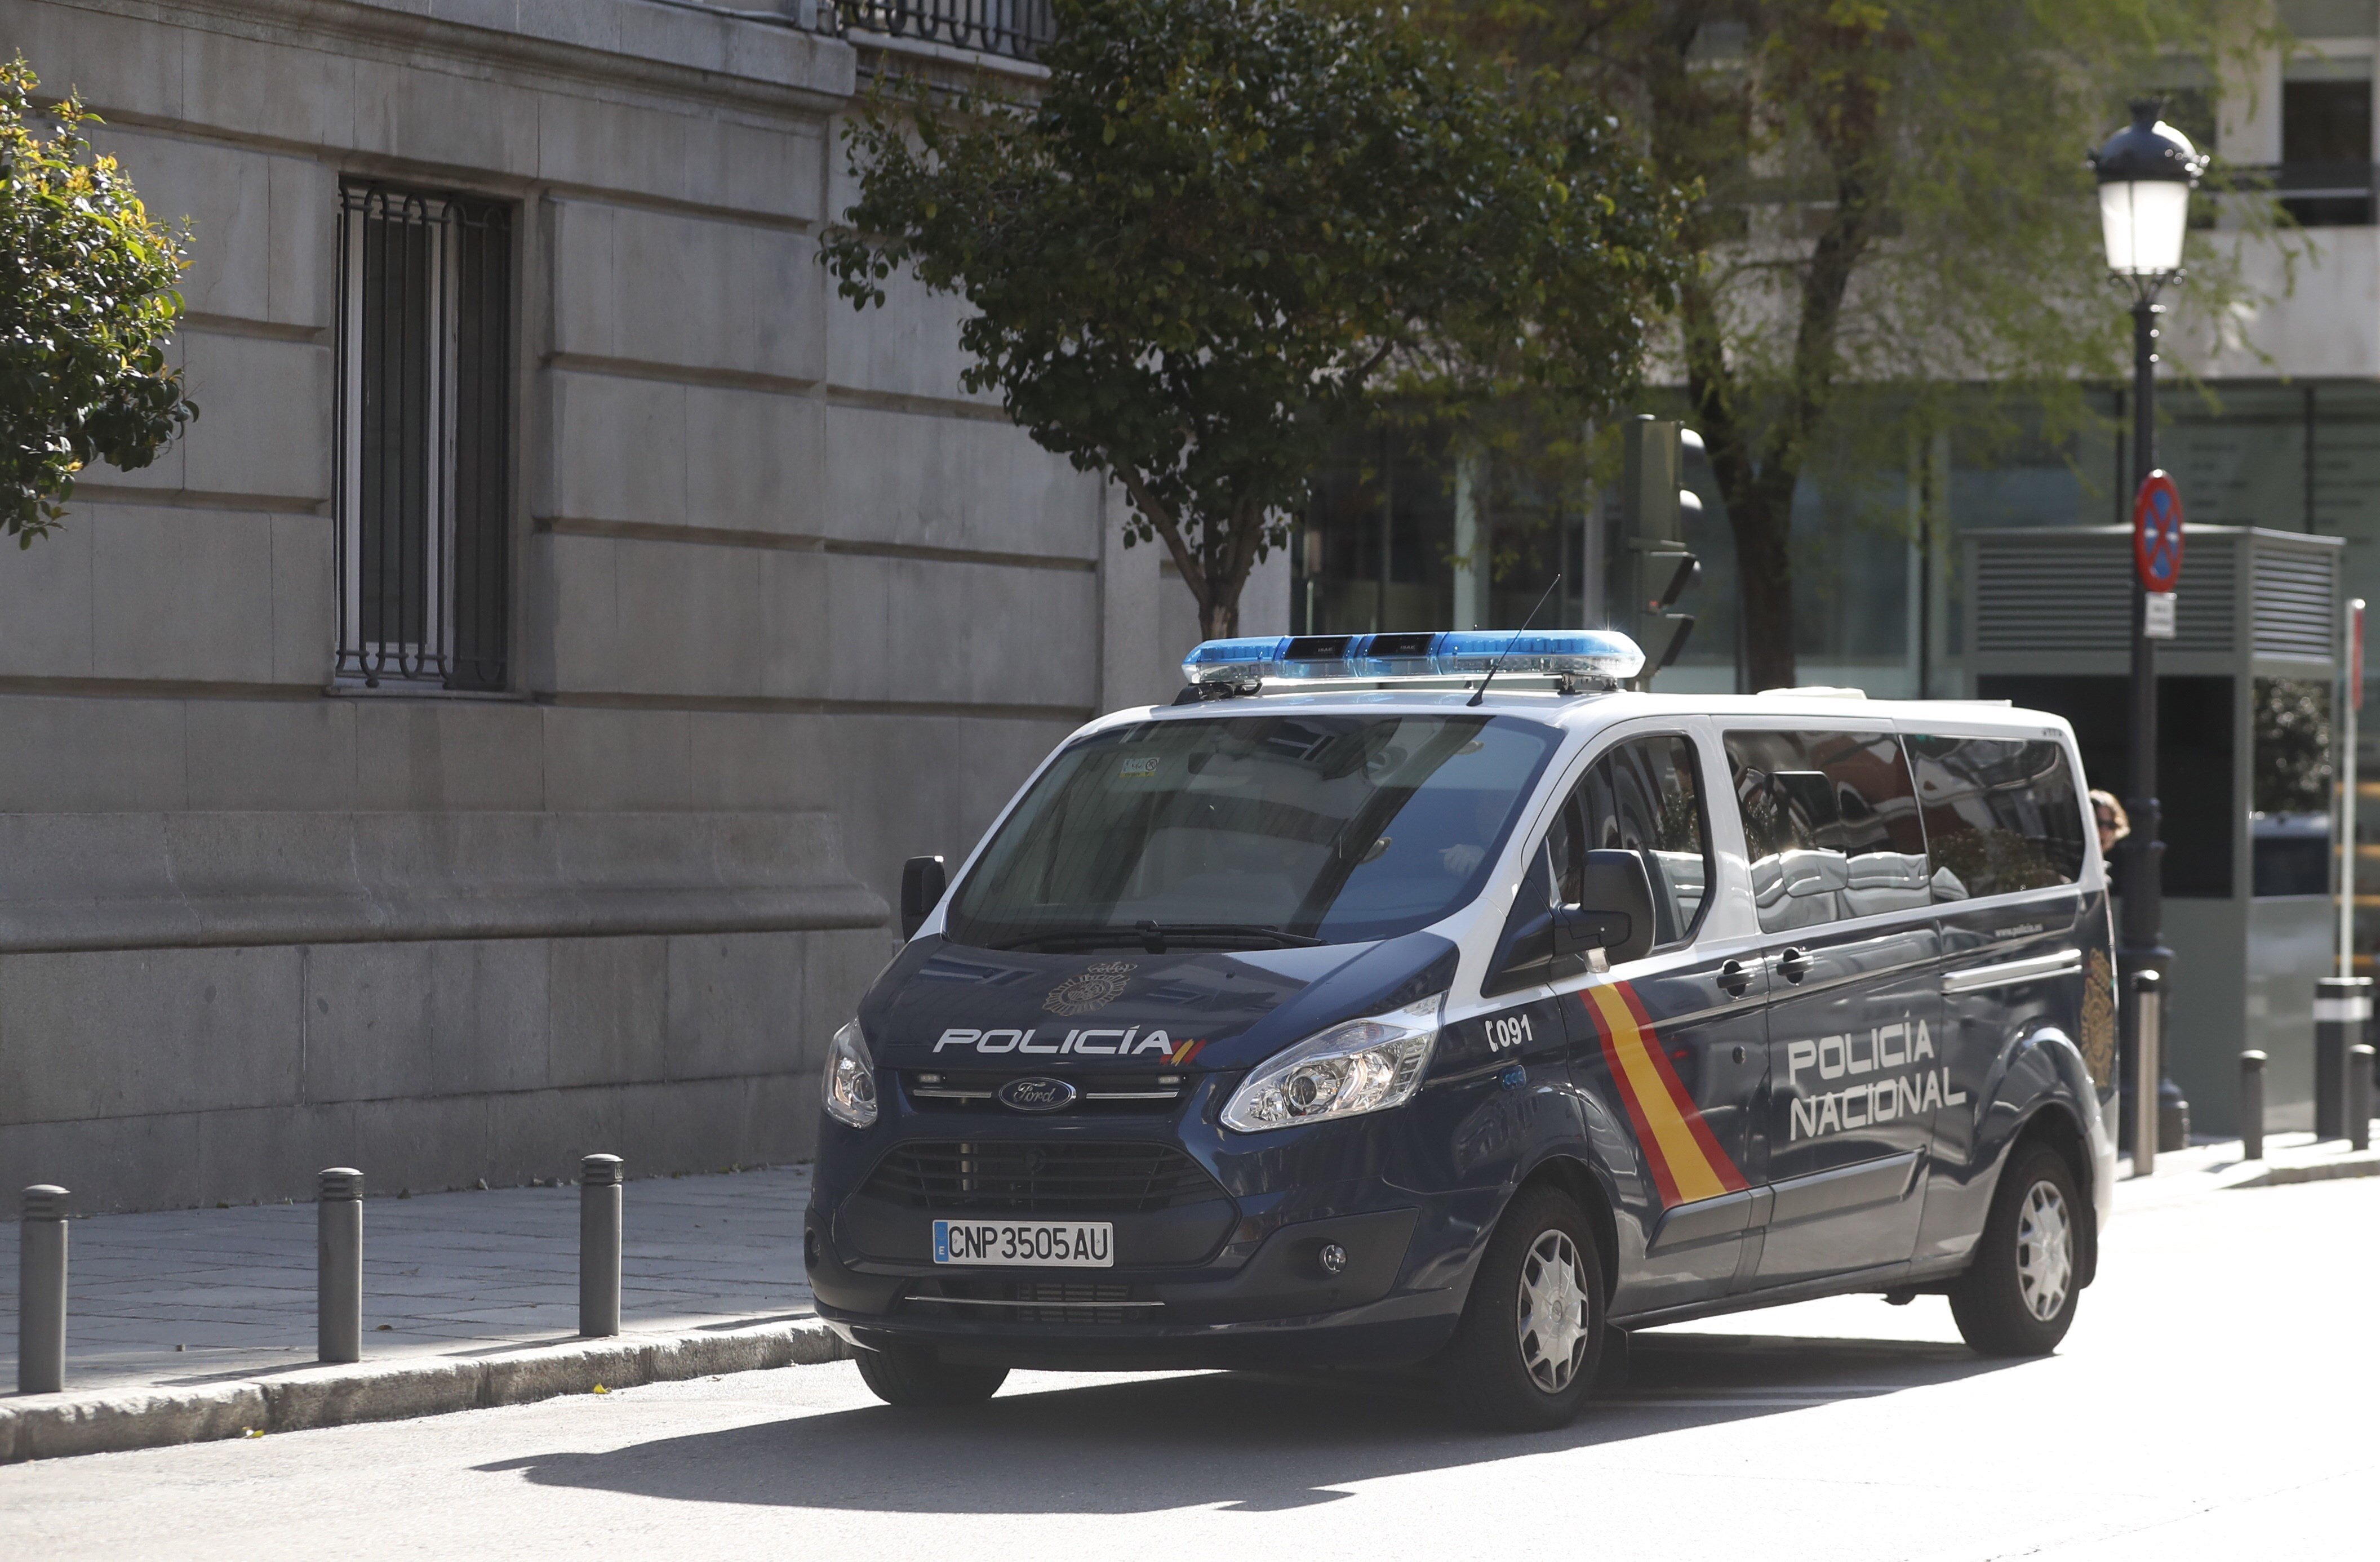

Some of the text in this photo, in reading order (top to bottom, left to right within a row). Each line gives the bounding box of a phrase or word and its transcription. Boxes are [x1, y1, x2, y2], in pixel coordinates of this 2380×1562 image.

[932, 1025, 1174, 1055] POLICÍA
[1496, 1013, 1533, 1048] 091
[1787, 1009, 1935, 1085] POLICÍA
[1014, 1082, 1056, 1102] Ford
[1790, 1066, 1967, 1141] NACIONAL
[938, 1245, 945, 1256] E
